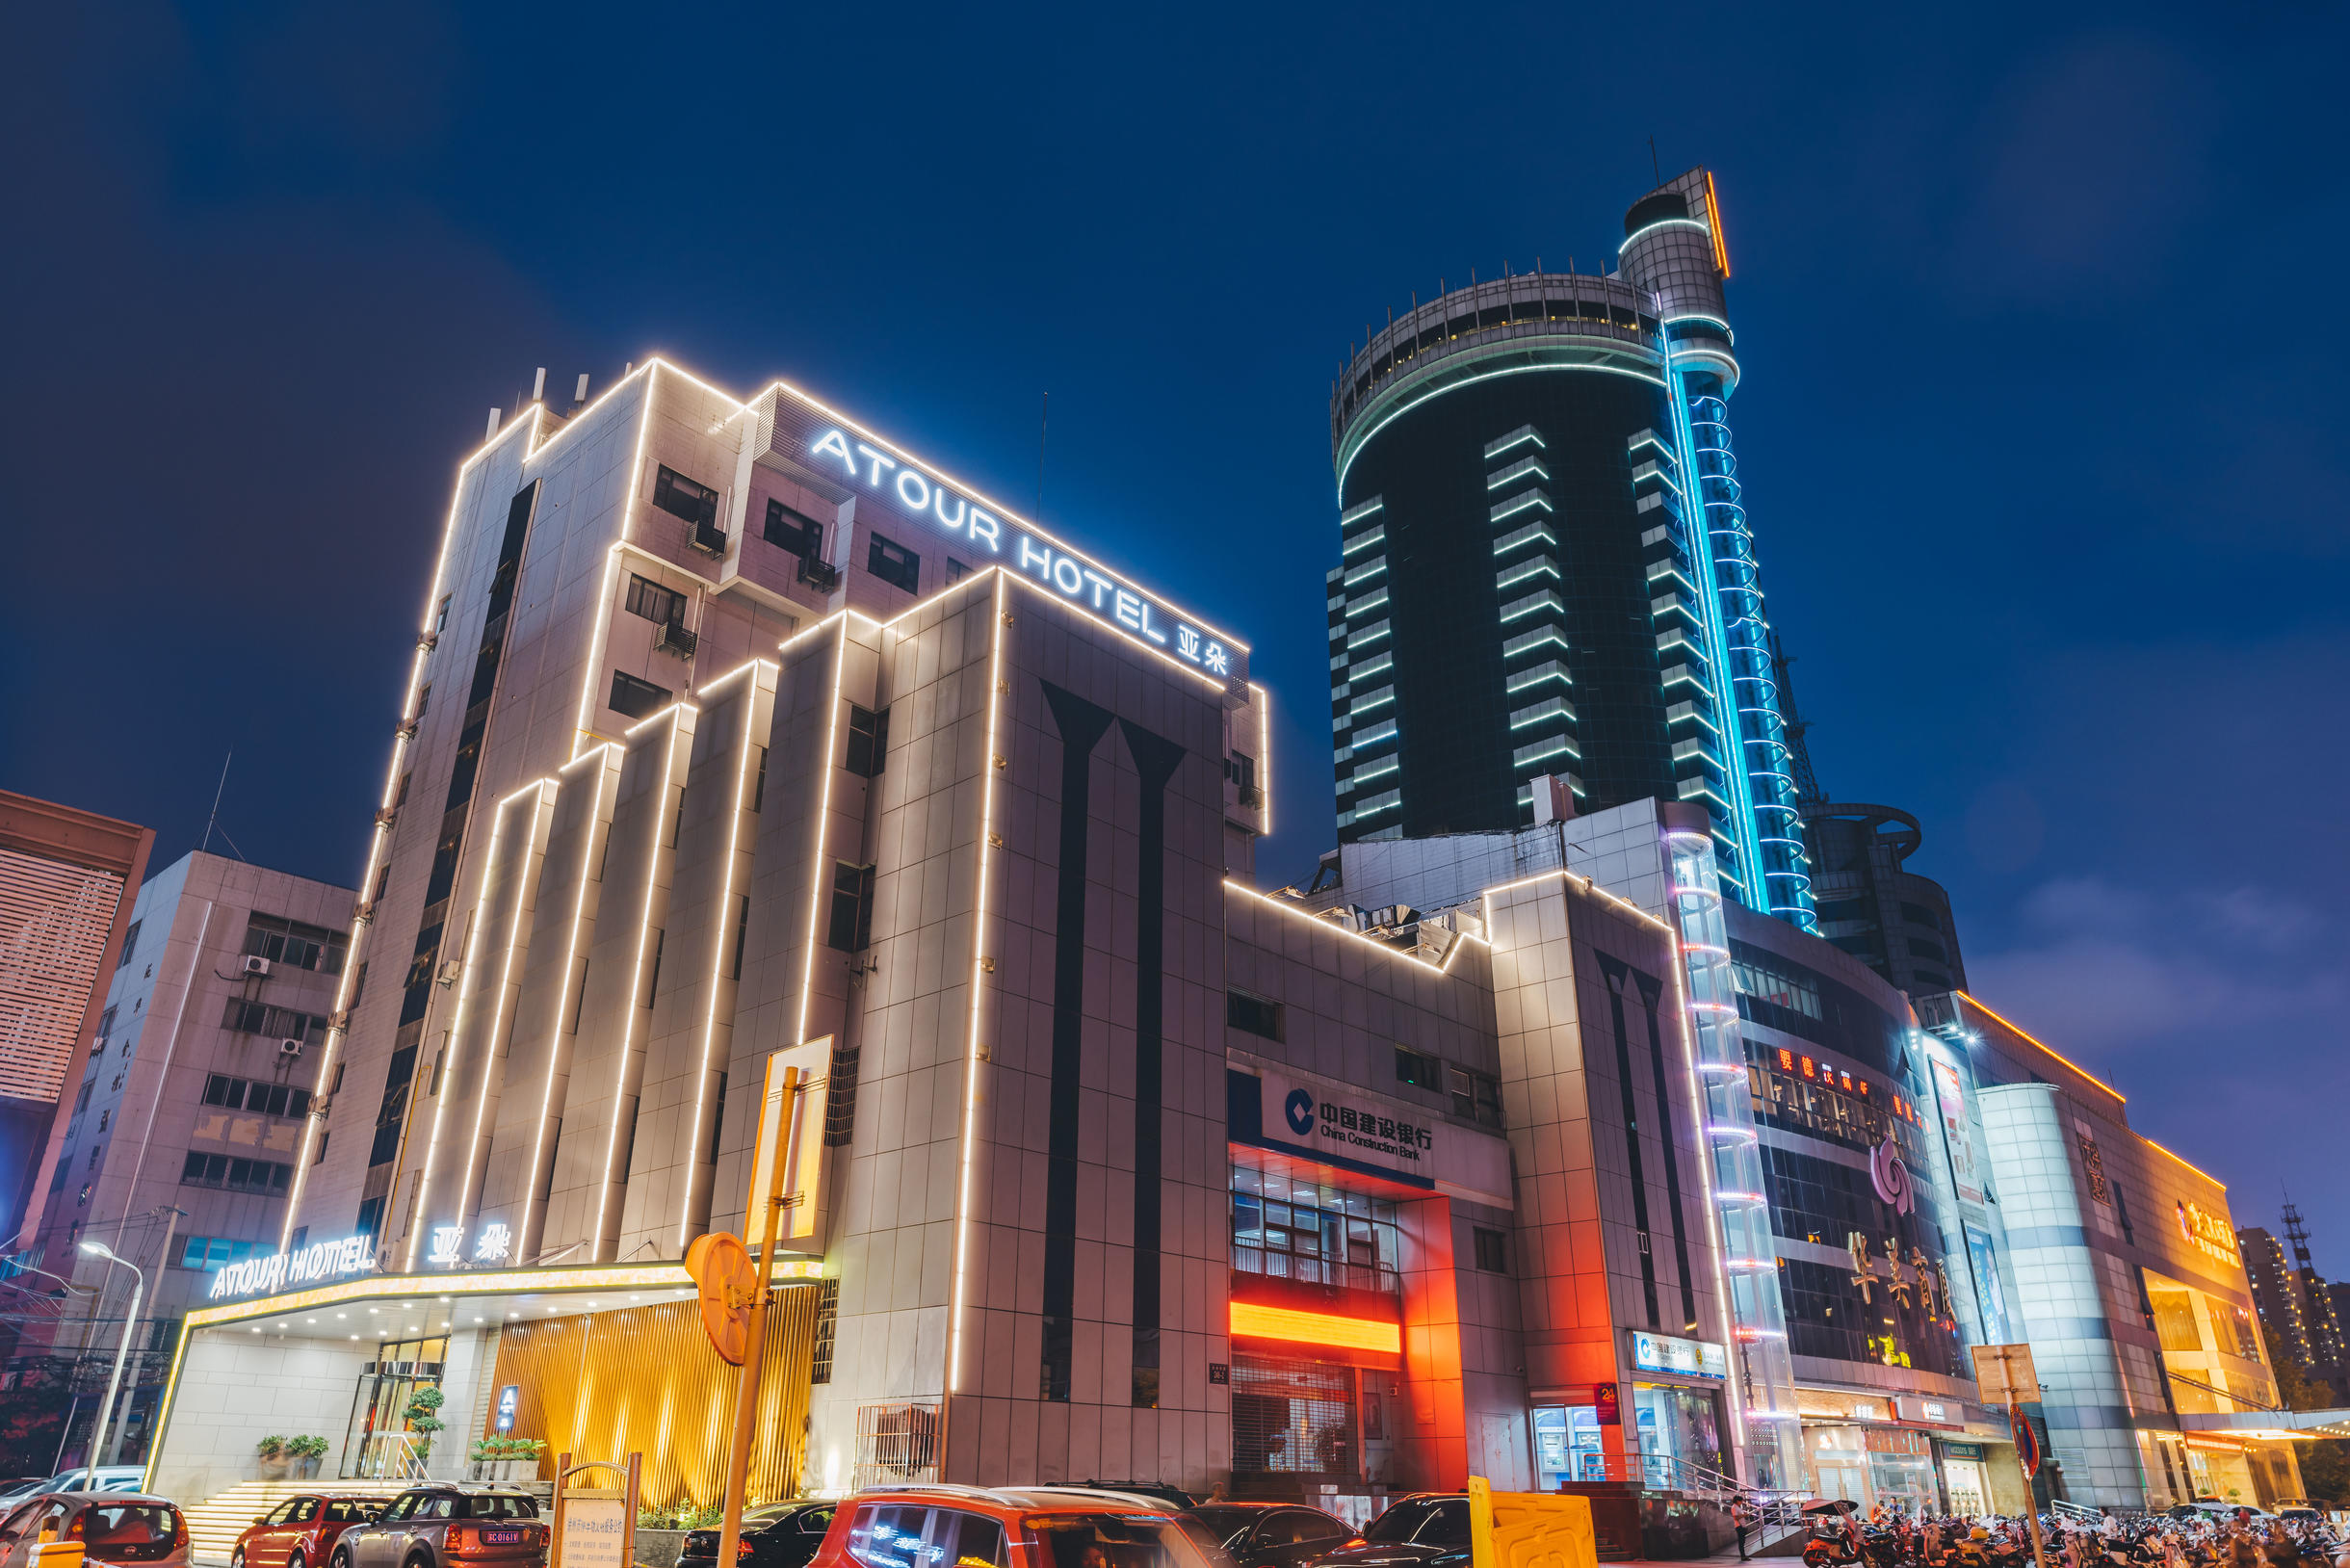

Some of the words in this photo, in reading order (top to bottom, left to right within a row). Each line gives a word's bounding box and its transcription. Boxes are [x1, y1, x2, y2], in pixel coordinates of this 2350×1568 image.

[812, 430, 1001, 552] ATOUR
[1021, 536, 1166, 643] HOTEL
[1177, 624, 1228, 675] 亚朵
[1319, 1102, 1432, 1150] 中国建设银行
[1320, 1124, 1346, 1142] China
[1348, 1132, 1397, 1157] Construction
[1399, 1145, 1421, 1162] Bank
[209, 1252, 290, 1299] ATOUR
[289, 1234, 376, 1282] HOTEL
[428, 1223, 511, 1263] 亚朵
[1602, 1388, 1615, 1400] 24
